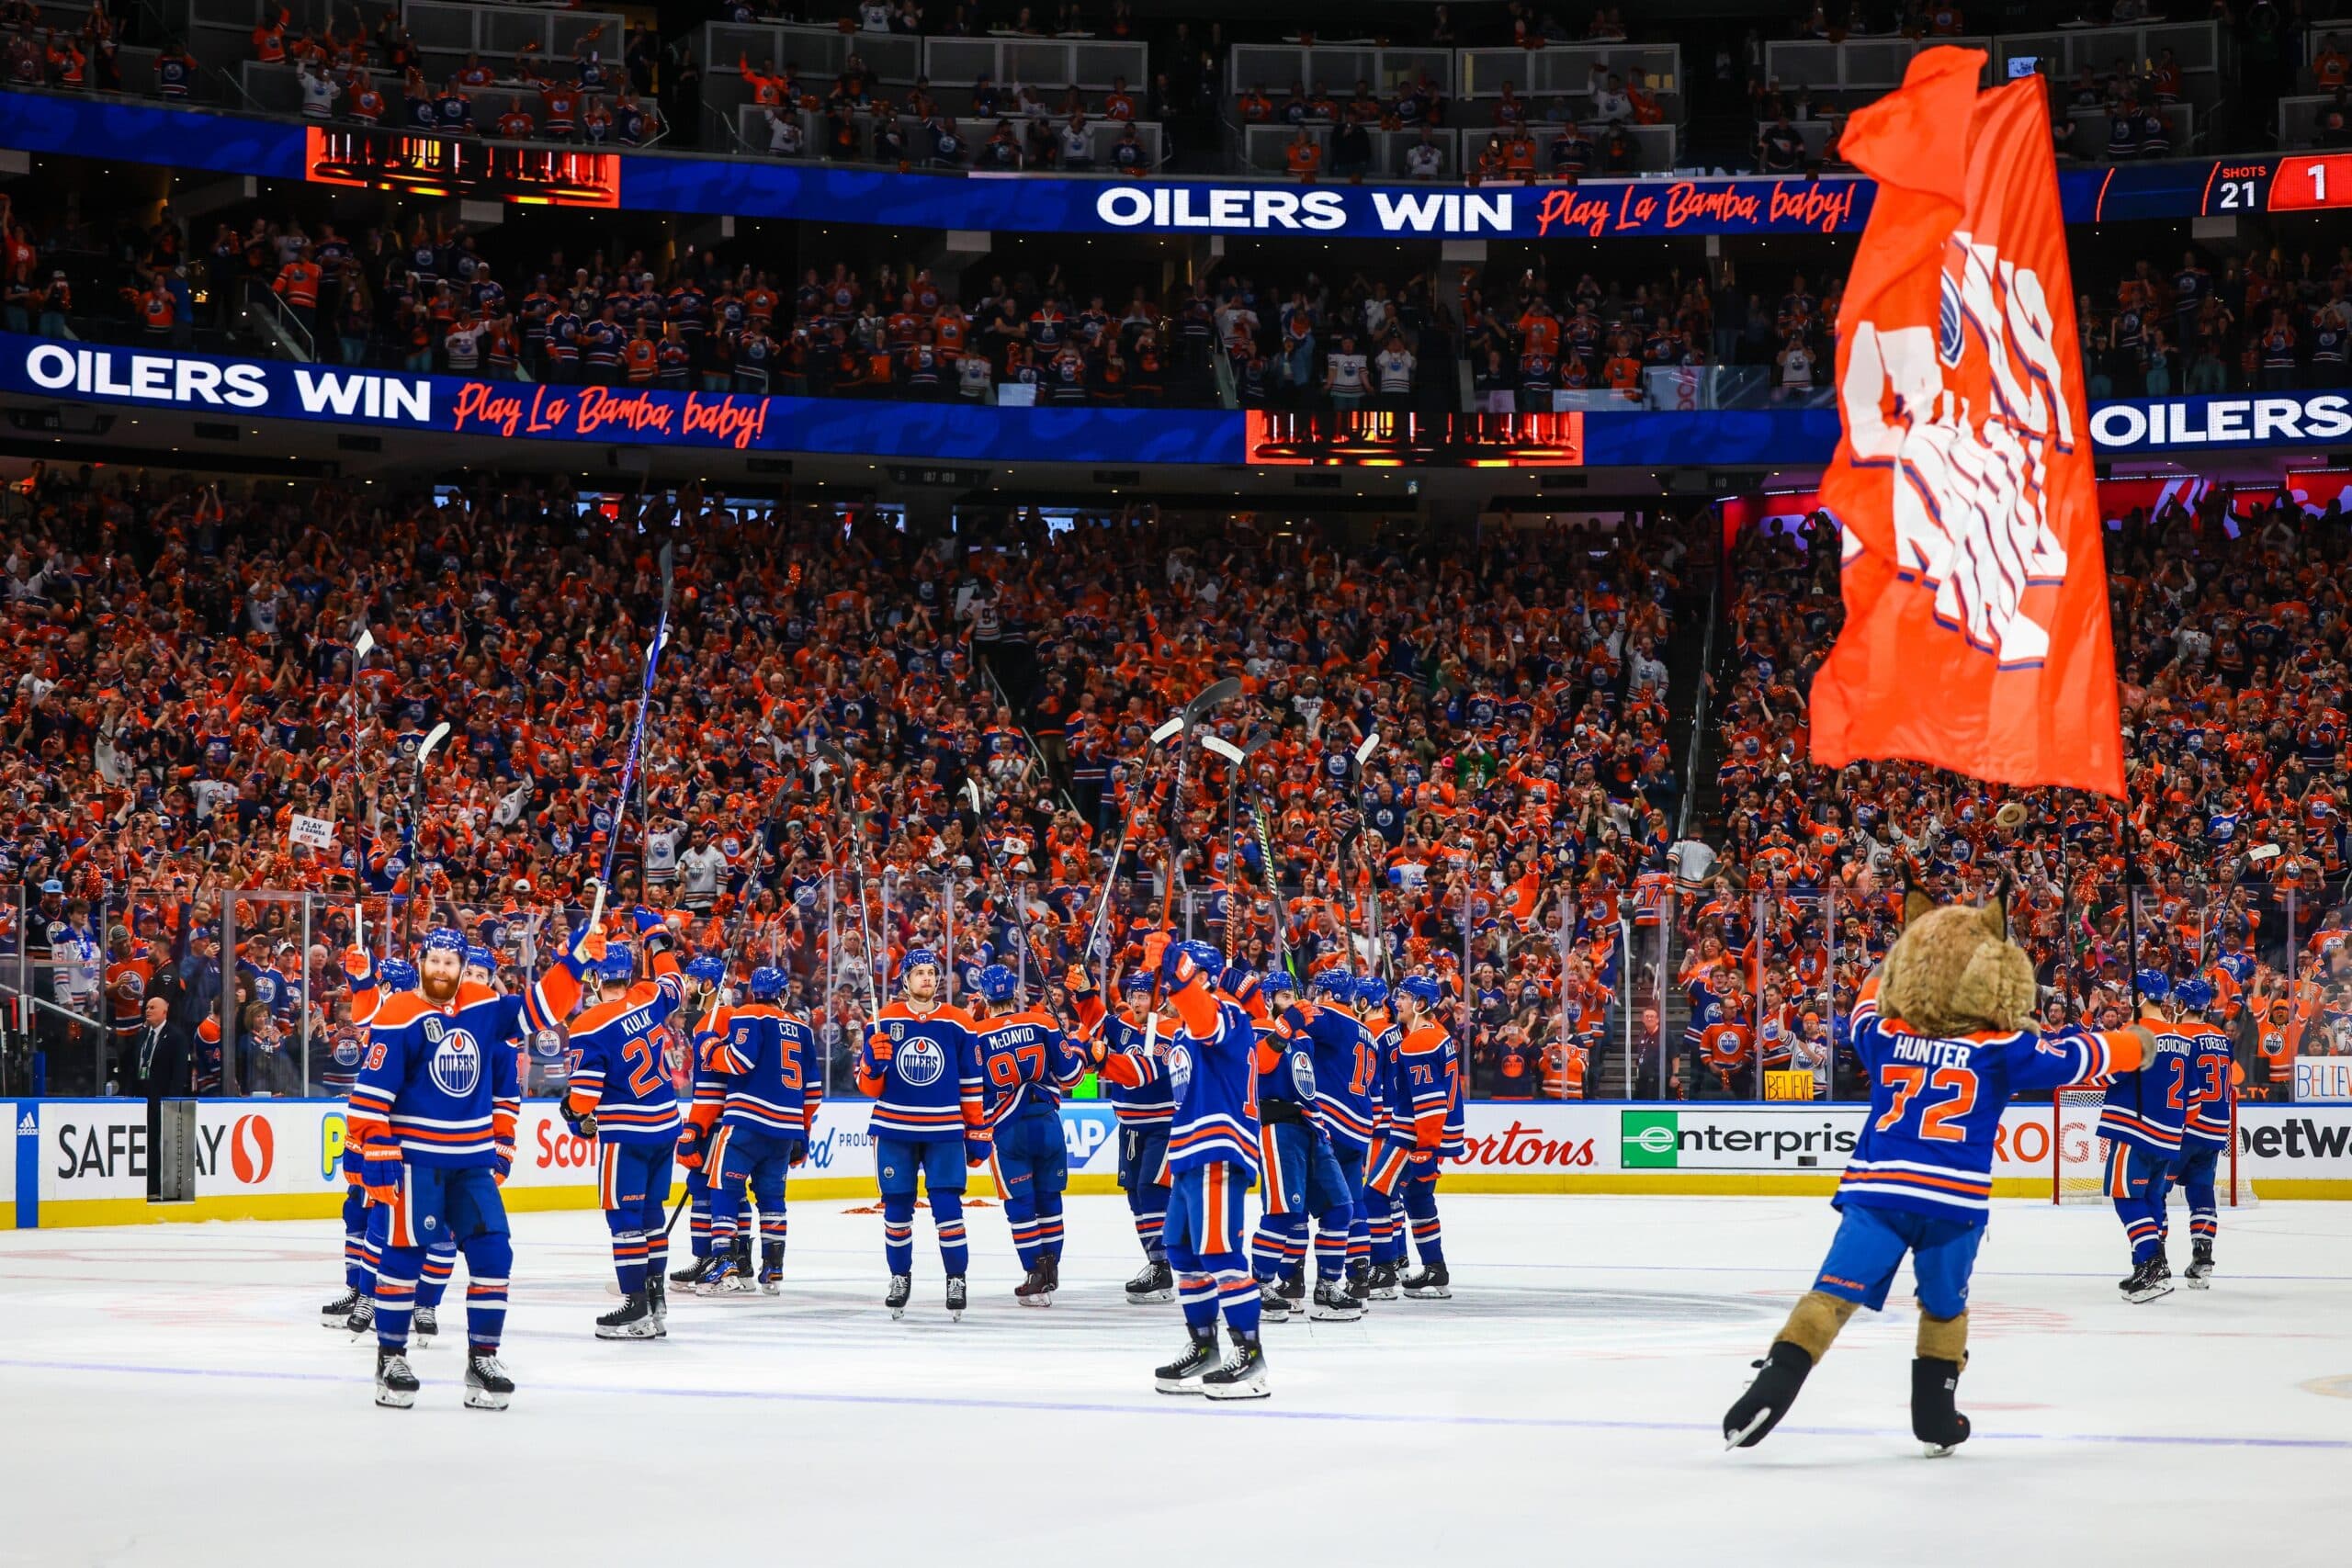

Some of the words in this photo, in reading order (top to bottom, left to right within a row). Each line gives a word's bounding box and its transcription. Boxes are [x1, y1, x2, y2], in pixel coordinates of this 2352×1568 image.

[2222, 166, 2267, 178] SHOTS
[2307, 164, 2325, 200] 1
[1097, 186, 1347, 231] OILERS
[1372, 193, 1512, 232] WIN
[1537, 190, 1609, 237] Play
[1616, 185, 1657, 231] La
[1665, 183, 1759, 229] Bamba,
[1770, 181, 1856, 232] baby!
[2221, 181, 2255, 209] 21
[27, 344, 269, 408] OILERS
[293, 369, 431, 422] WIN
[454, 383, 522, 437] Play
[526, 385, 570, 433] La
[576, 386, 674, 435] Bamba,
[683, 391, 770, 449] baby!
[2089, 395, 2352, 447] OILERS
[302, 819, 322, 829] PLAY
[621, 1009, 653, 1036] KULAK
[735, 1028, 750, 1044] 5
[778, 1022, 799, 1039] CECI
[988, 1027, 1035, 1051] McDAVID
[1059, 1039, 1073, 1059] 9
[1893, 1034, 1971, 1068] HUNTER
[439, 1054, 475, 1072] OILERS
[622, 1022, 673, 1100] 27
[781, 1039, 803, 1090] 5
[903, 1055, 938, 1070] OILERS
[987, 1043, 1046, 1101] 97
[1409, 1064, 1433, 1085] 71
[1242, 1046, 1260, 1122] 1
[1767, 1074, 1813, 1100] BELIEVE
[2166, 1057, 2185, 1110] 2
[1874, 1064, 1978, 1143] 72
[1439, 1119, 1595, 1167] ortons
